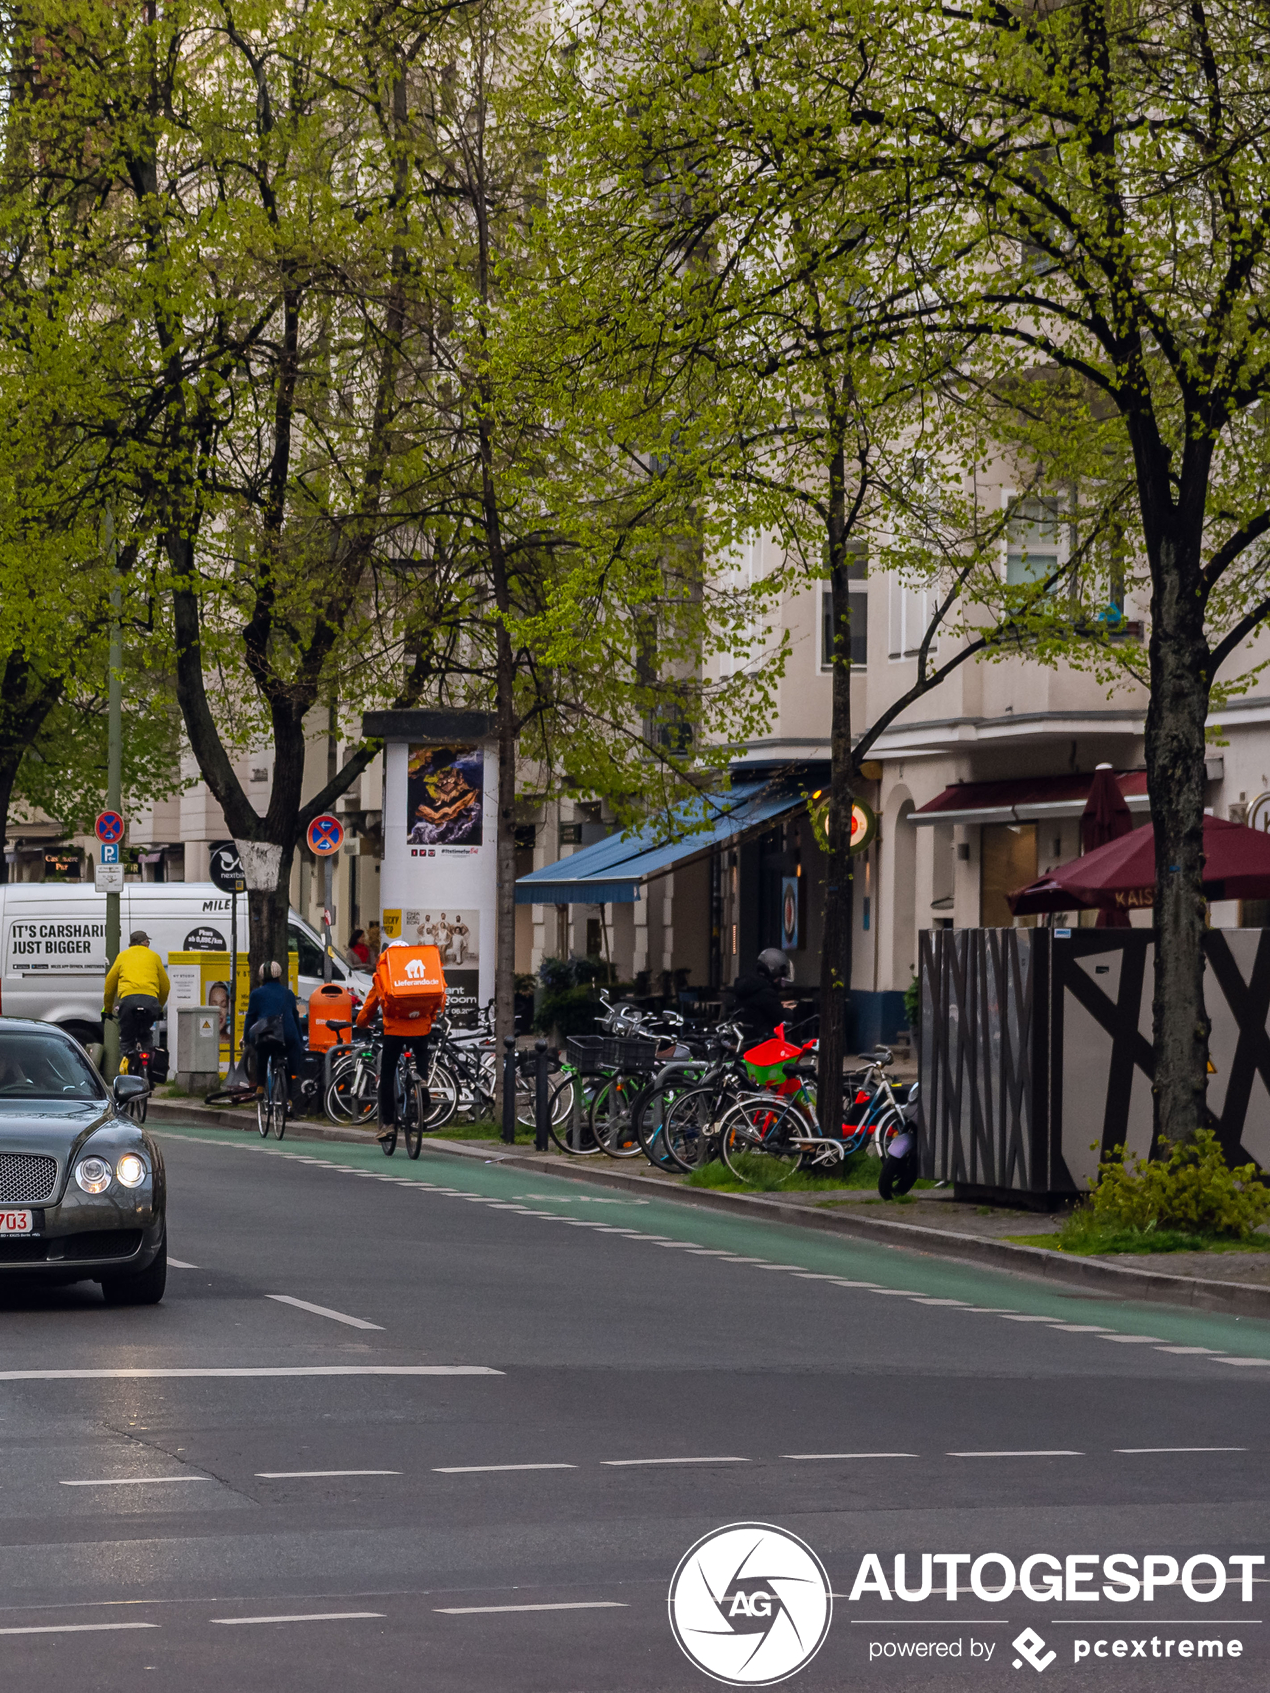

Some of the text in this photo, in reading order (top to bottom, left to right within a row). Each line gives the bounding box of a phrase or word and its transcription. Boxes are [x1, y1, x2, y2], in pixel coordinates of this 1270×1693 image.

[1115, 888, 1154, 908] KAIS
[202, 899, 233, 912] MILE
[40, 925, 121, 938] CARSHARI
[12, 941, 91, 954] JUST BIGGER
[393, 978, 439, 988] Lieferando.de
